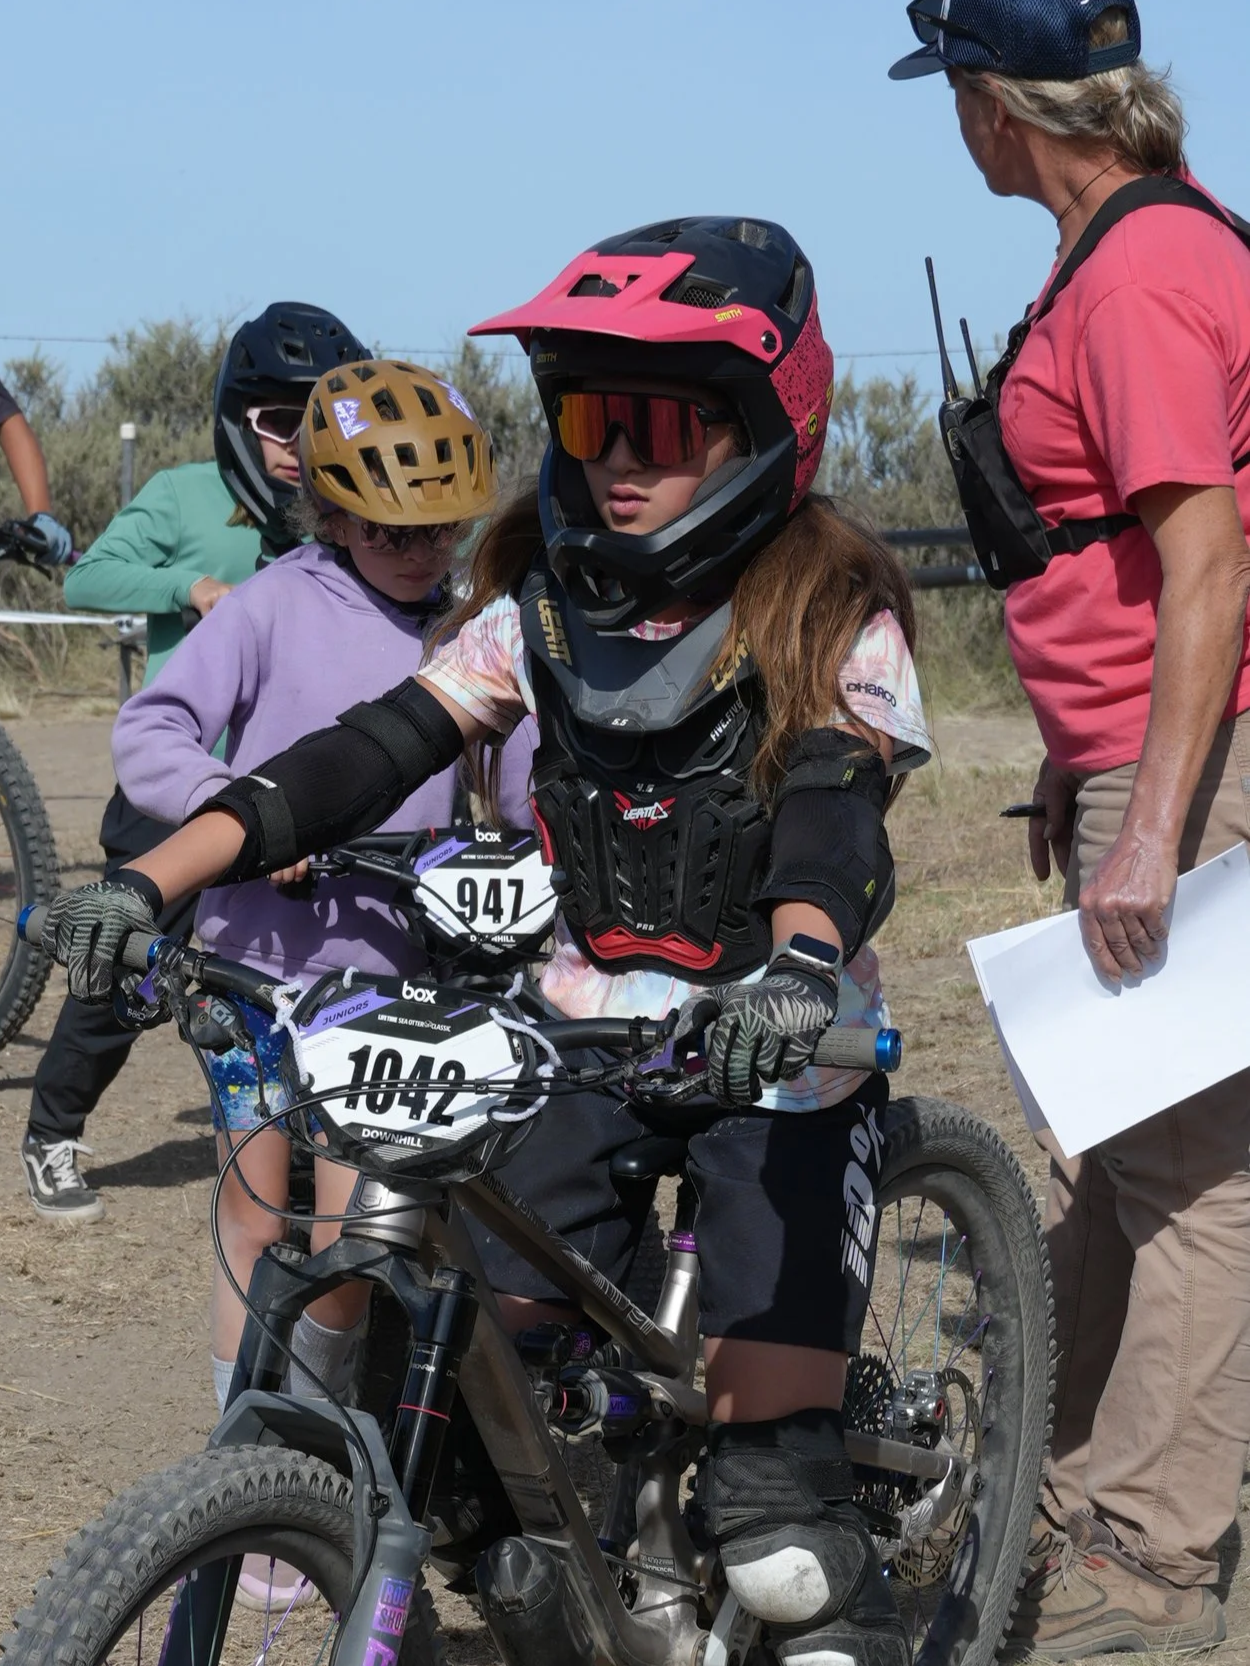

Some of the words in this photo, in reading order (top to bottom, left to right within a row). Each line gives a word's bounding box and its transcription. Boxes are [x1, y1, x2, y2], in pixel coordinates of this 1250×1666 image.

[714, 308, 742, 323] SMITH
[538, 599, 572, 666] LEATT
[475, 828, 501, 842] box
[422, 846, 453, 869] JUNIORS
[456, 877, 524, 924] 947
[470, 935, 515, 943] DNHILL
[401, 980, 438, 1005] box
[322, 1000, 369, 1026] JUNIORS
[343, 1044, 467, 1127] 1042
[362, 1128, 423, 1149] DOWNHILL
[383, 1584, 412, 1608] ROC
